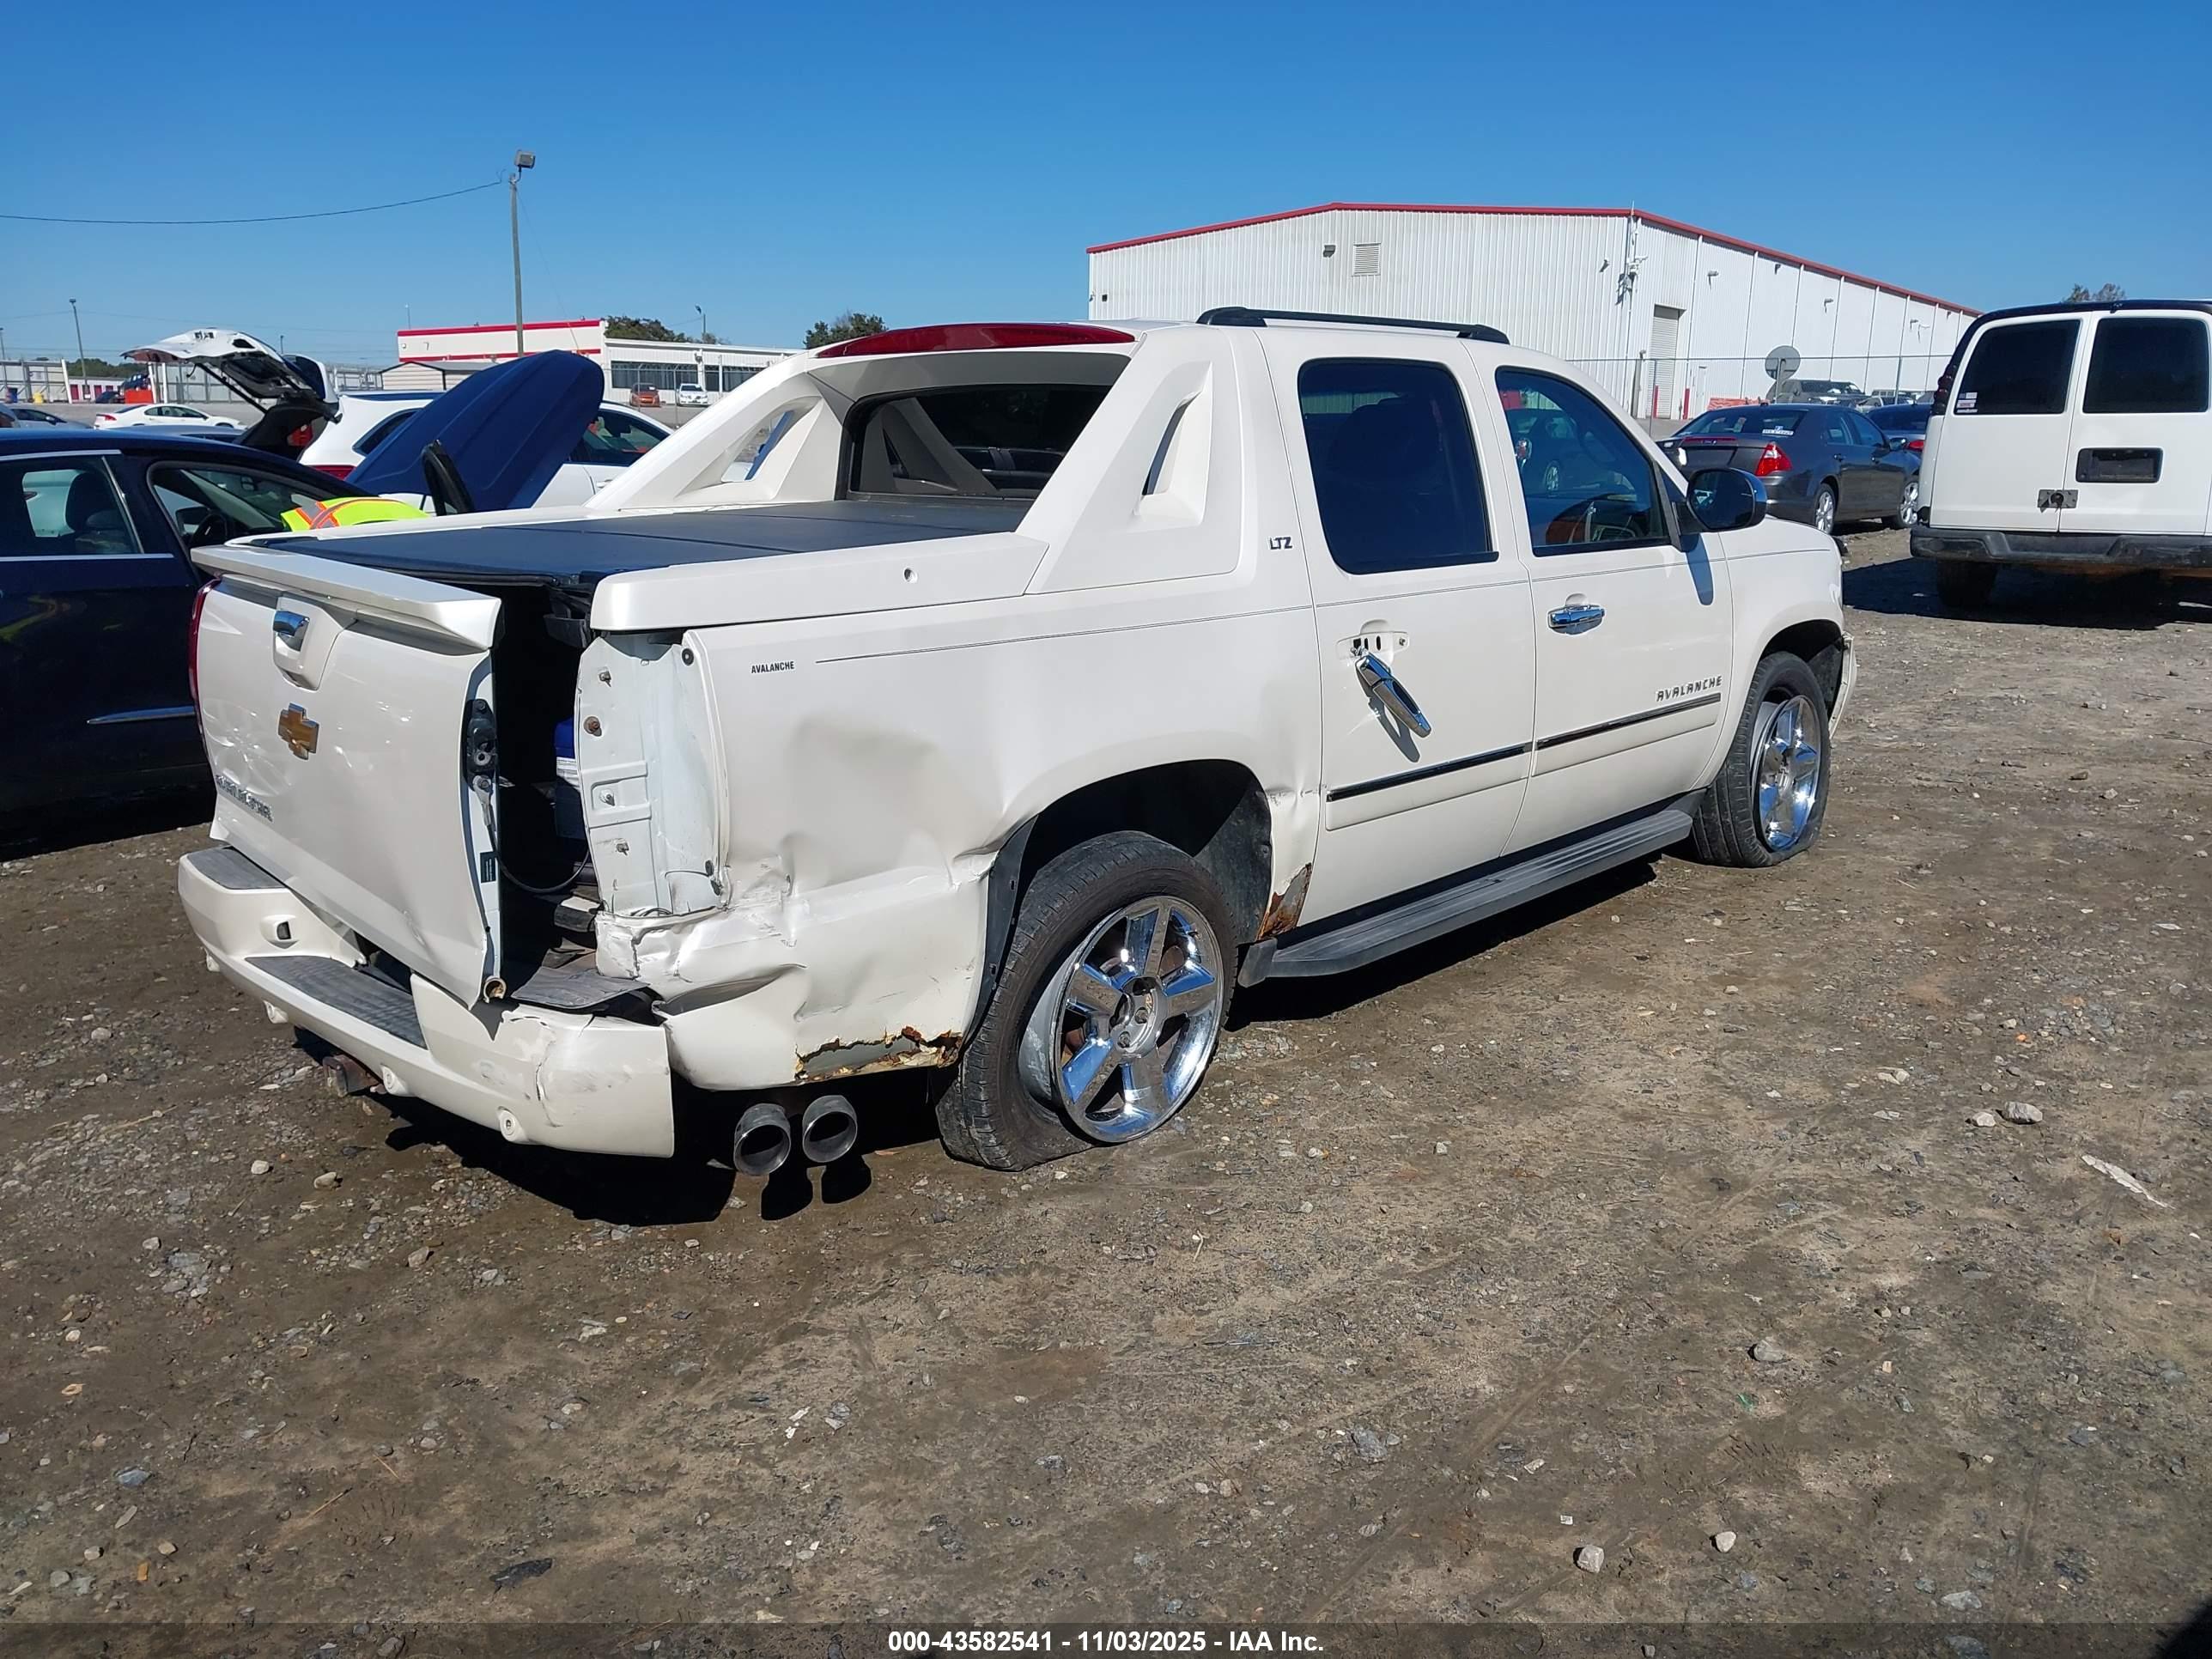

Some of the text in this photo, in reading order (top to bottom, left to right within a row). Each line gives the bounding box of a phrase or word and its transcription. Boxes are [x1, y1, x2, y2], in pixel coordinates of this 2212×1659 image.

[1268, 536, 1293, 550] LTZ
[750, 660, 795, 674] AVALANCHE
[1656, 675, 1723, 702] AVALANCHE
